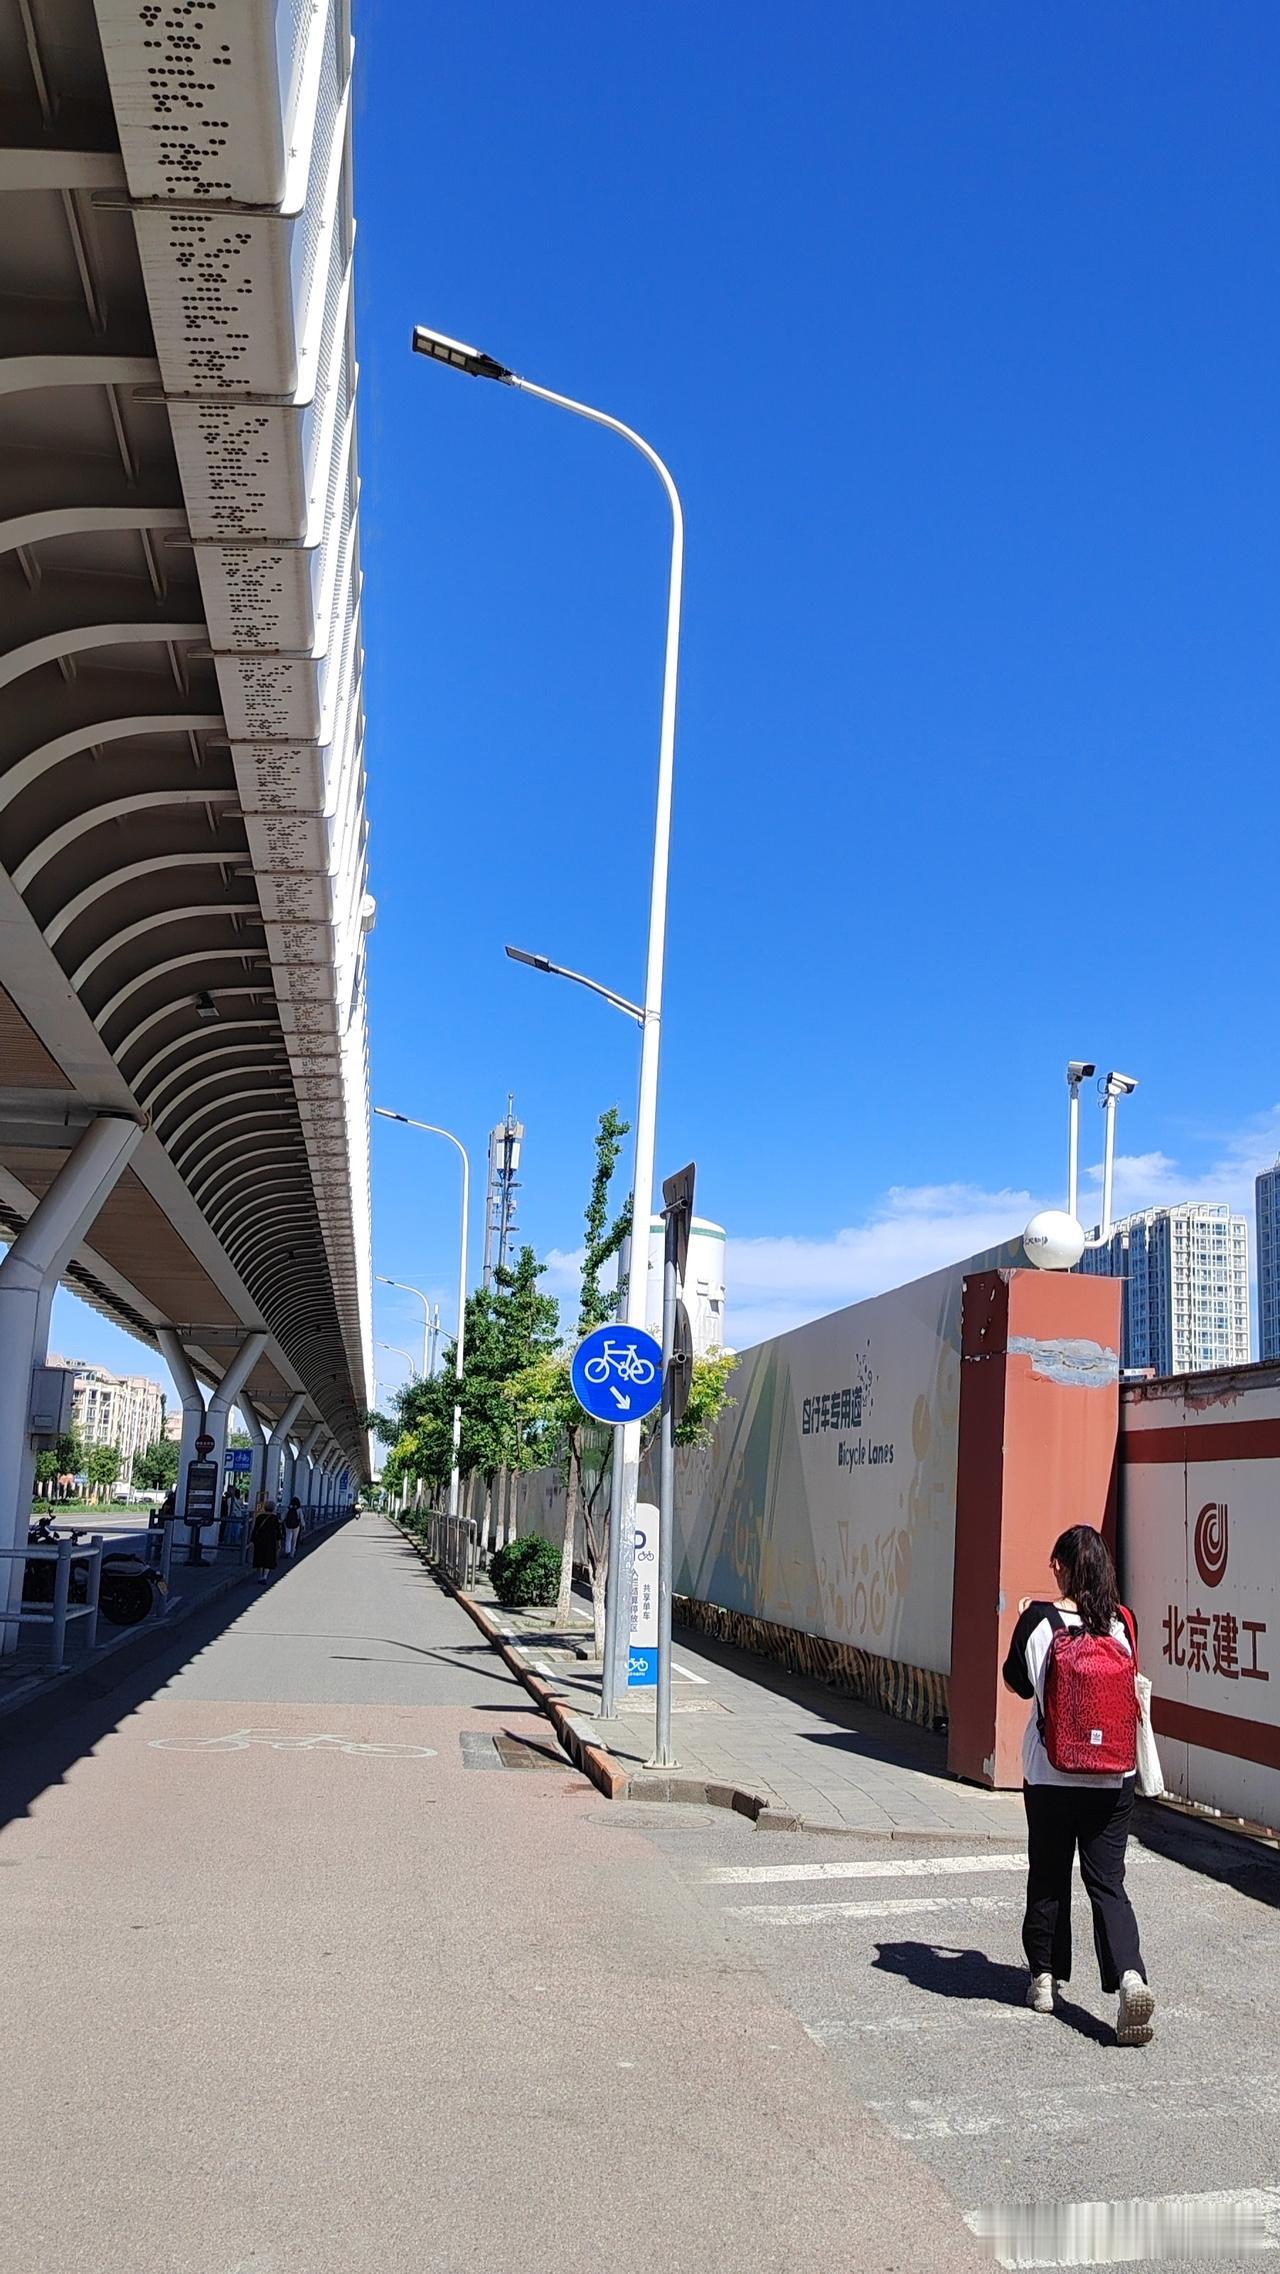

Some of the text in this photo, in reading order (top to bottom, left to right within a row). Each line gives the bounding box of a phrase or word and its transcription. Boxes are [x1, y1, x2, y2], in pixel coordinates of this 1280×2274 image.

[802, 1385, 863, 1435] 自行车专用道
[838, 1437, 894, 1474] Bicycle Lanes
[643, 1583, 651, 1620] 共享单车
[1162, 1604, 1270, 1682] 北京建工
